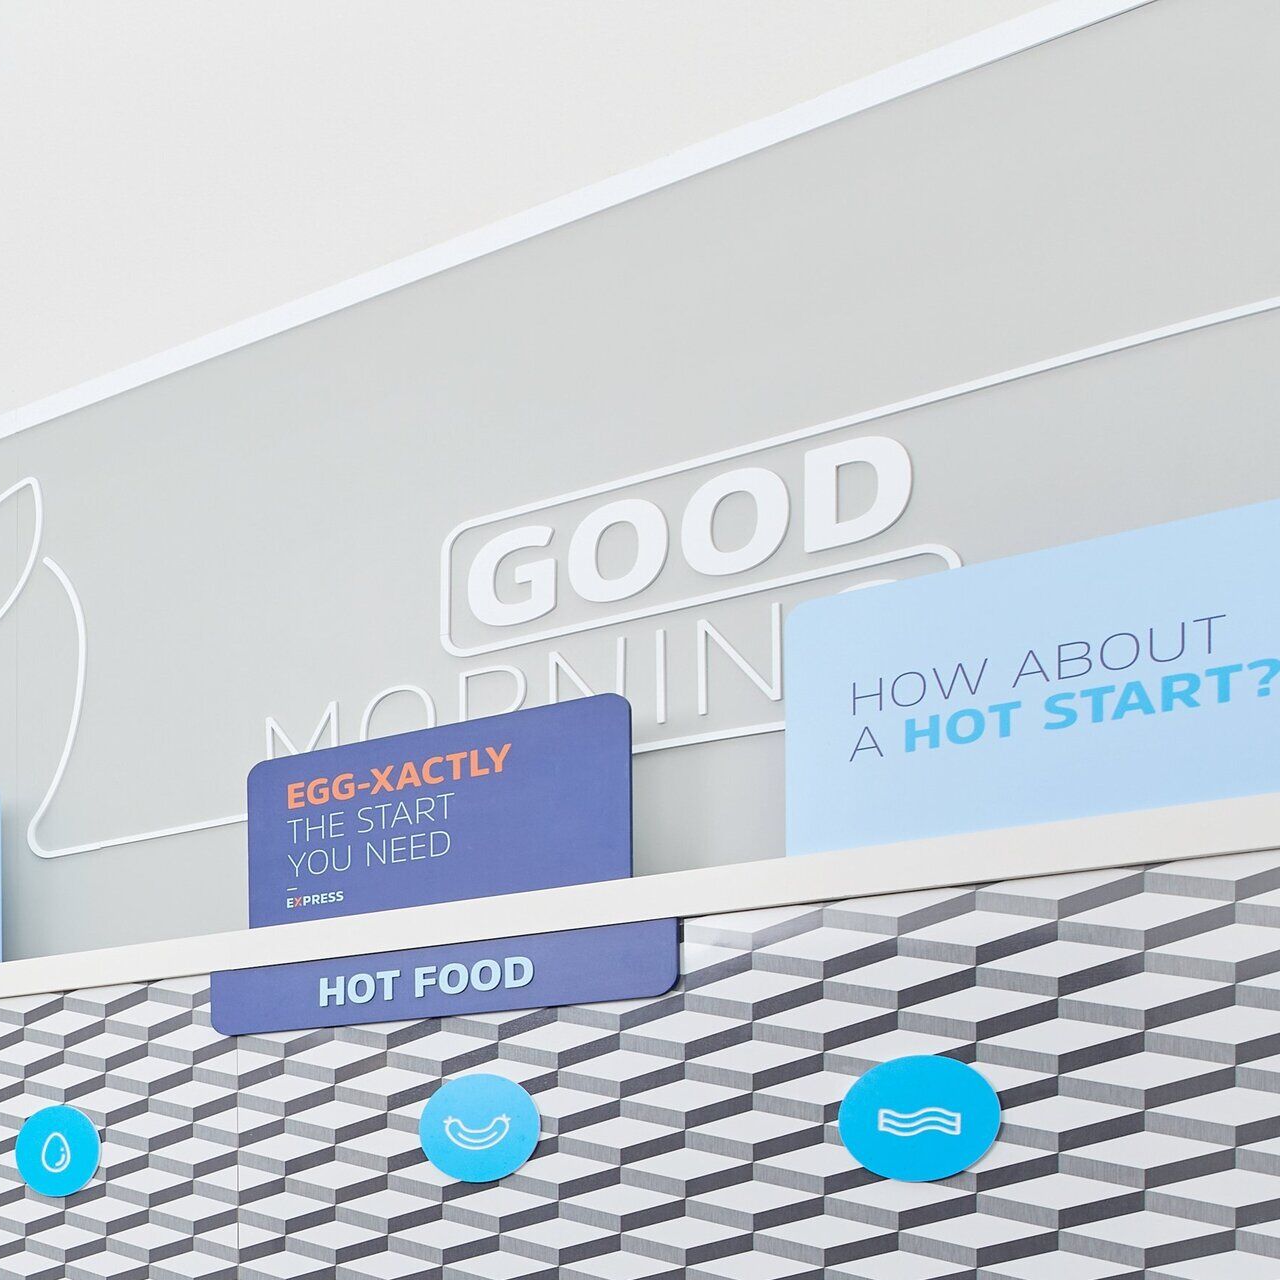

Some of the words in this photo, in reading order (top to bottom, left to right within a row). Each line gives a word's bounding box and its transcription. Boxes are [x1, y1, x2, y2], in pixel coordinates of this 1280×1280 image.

[467, 436, 913, 626] GOOD
[851, 657, 989, 716] HOW
[1012, 614, 1227, 688] ABOUT
[849, 726, 884, 762] A
[904, 700, 1022, 753] HOT
[1043, 657, 1280, 731] START?
[286, 743, 512, 810] EGG-XACTLY
[286, 811, 345, 844] THE
[357, 792, 455, 834] START
[287, 845, 351, 877] YOU
[366, 830, 451, 867] NEED
[286, 890, 344, 909] EXPRESS
[319, 969, 401, 1007] HOT
[414, 956, 535, 999] FOOD
